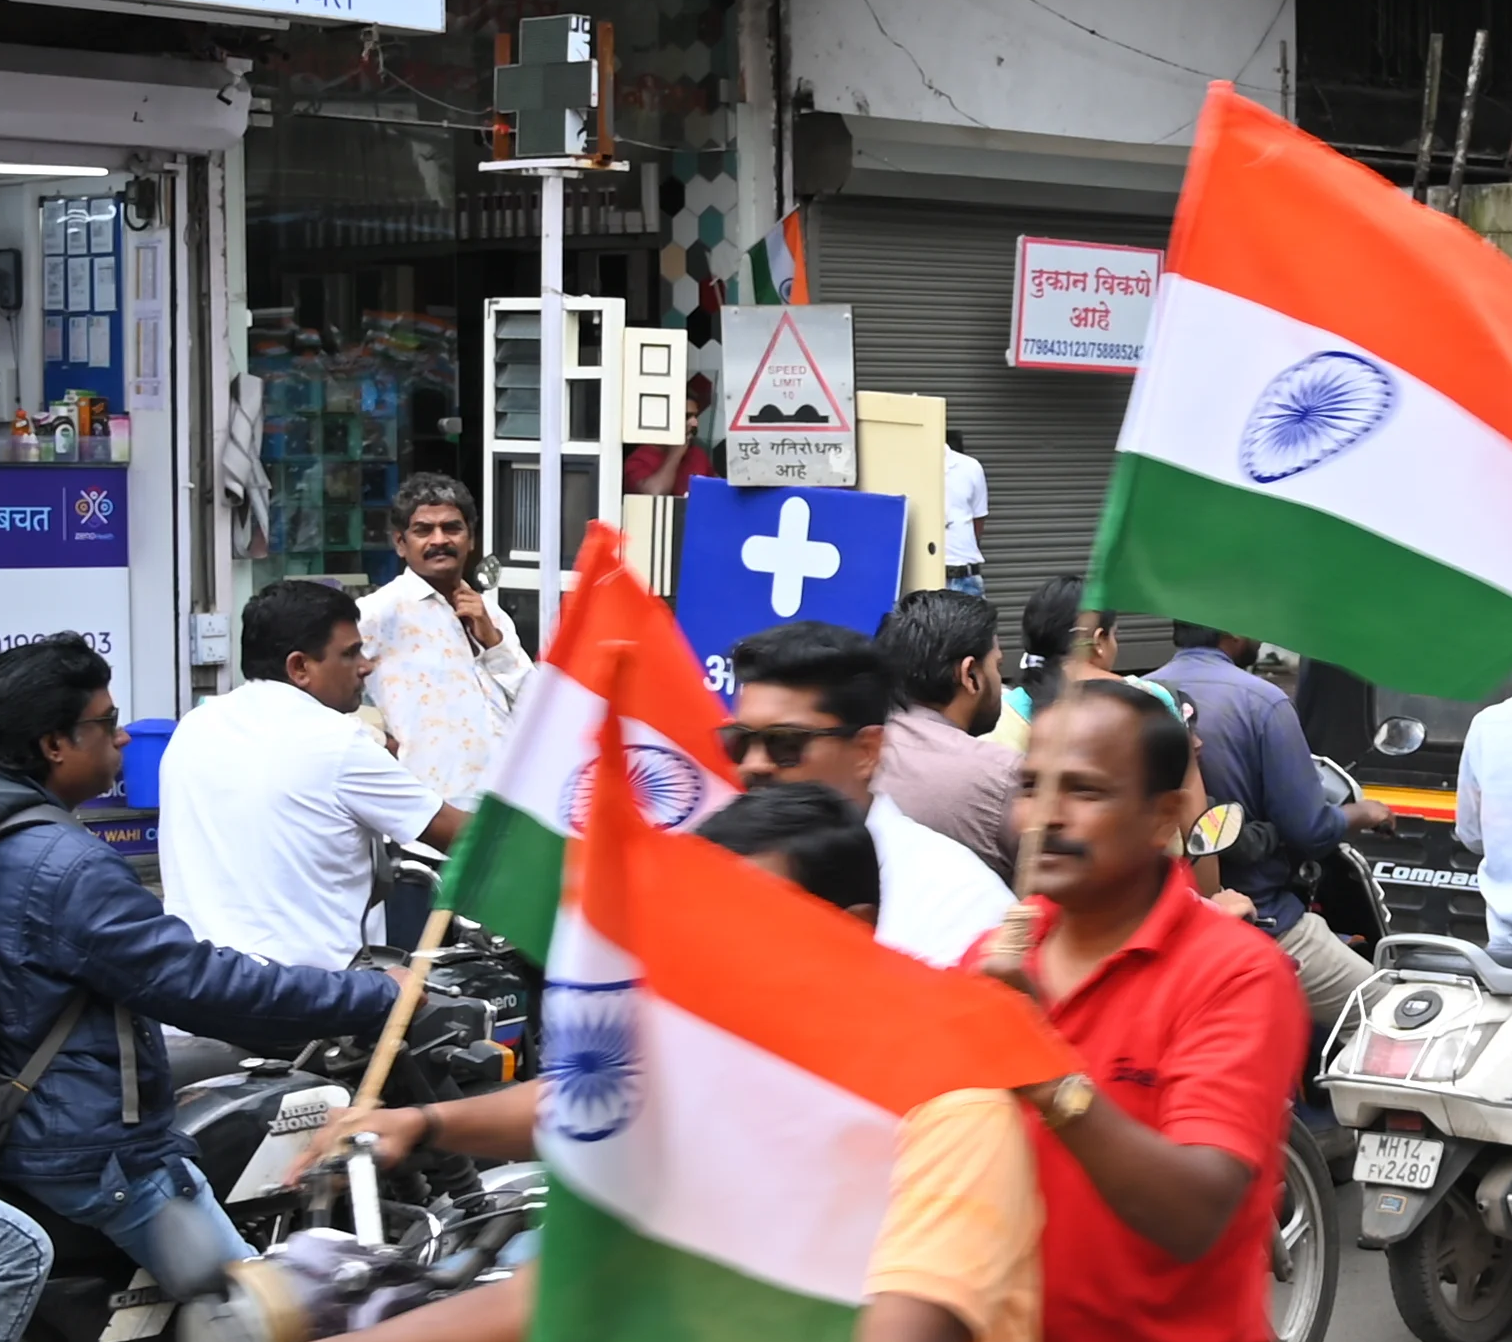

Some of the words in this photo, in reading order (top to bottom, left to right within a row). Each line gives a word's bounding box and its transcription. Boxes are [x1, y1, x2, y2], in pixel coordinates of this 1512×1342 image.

[1031, 269, 1088, 298] दुकान
[1095, 267, 1152, 297] विकणे
[1069, 301, 1111, 331] आहे
[768, 365, 807, 375] SPEED
[773, 378, 802, 387] LIMIT
[783, 391, 795, 400] 10
[738, 437, 761, 460] पुढे
[770, 437, 842, 455] गतिरोधक
[776, 460, 807, 479] आहे
[105, 829, 141, 842] WAHI
